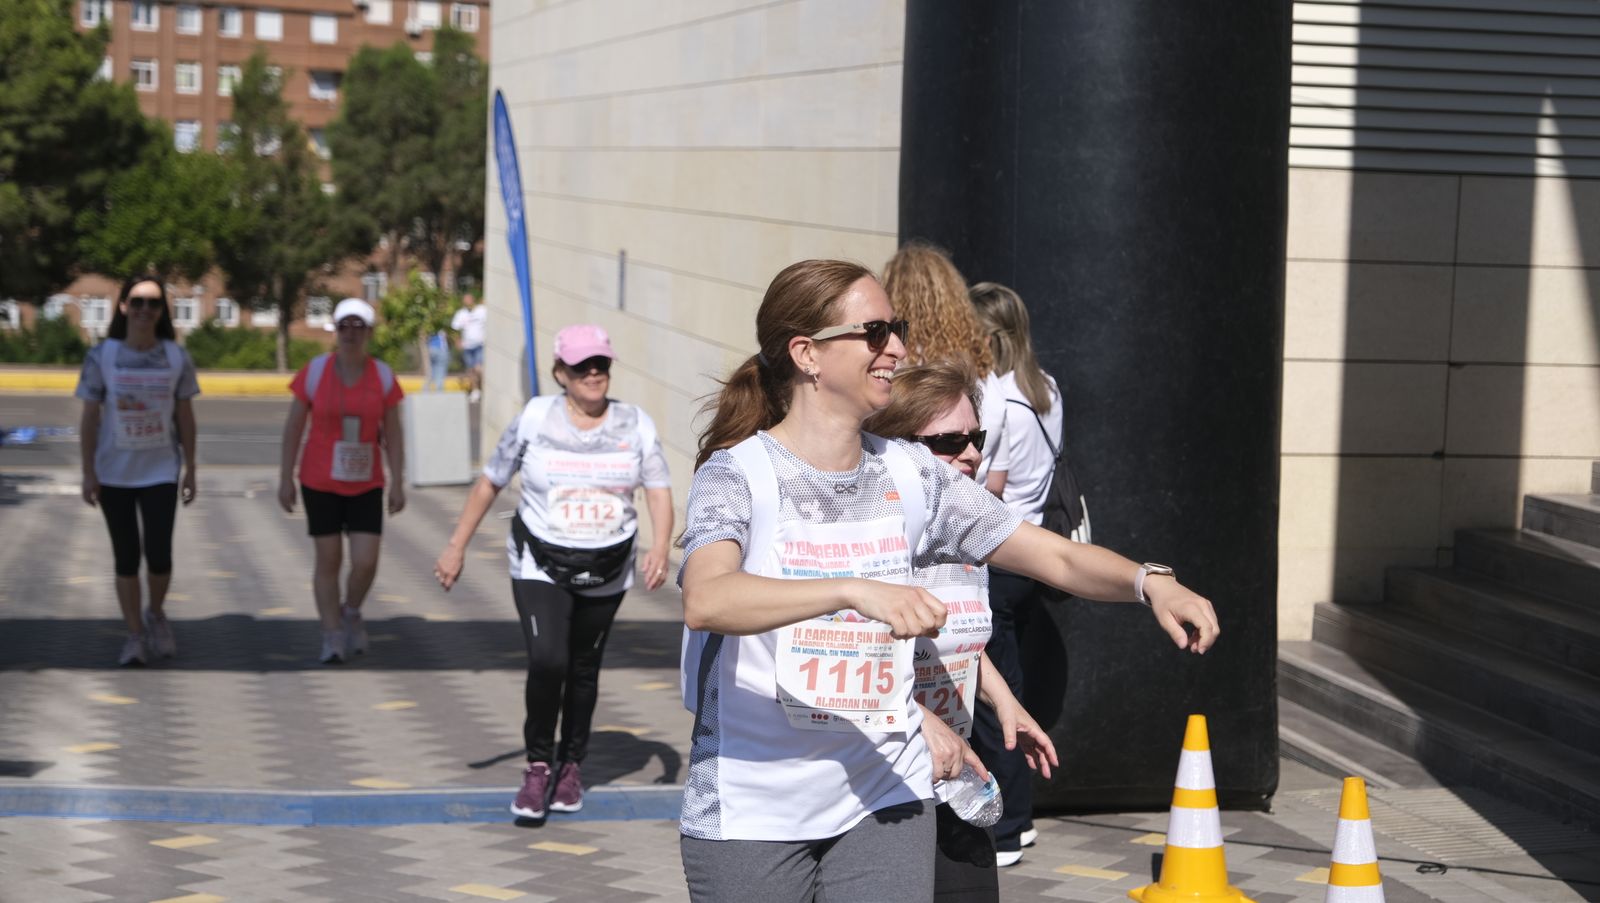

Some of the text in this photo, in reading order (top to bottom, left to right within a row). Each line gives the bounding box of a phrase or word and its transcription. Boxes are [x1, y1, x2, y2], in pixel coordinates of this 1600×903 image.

[561, 503, 615, 519] 1112
[851, 541, 876, 557] SIN
[805, 628, 855, 643] CARRERA
[856, 631, 873, 644] SIN
[802, 647, 828, 656] MUNDIAL
[933, 663, 947, 675] SIN
[949, 659, 969, 672] HUMO
[799, 658, 894, 695] 1115
